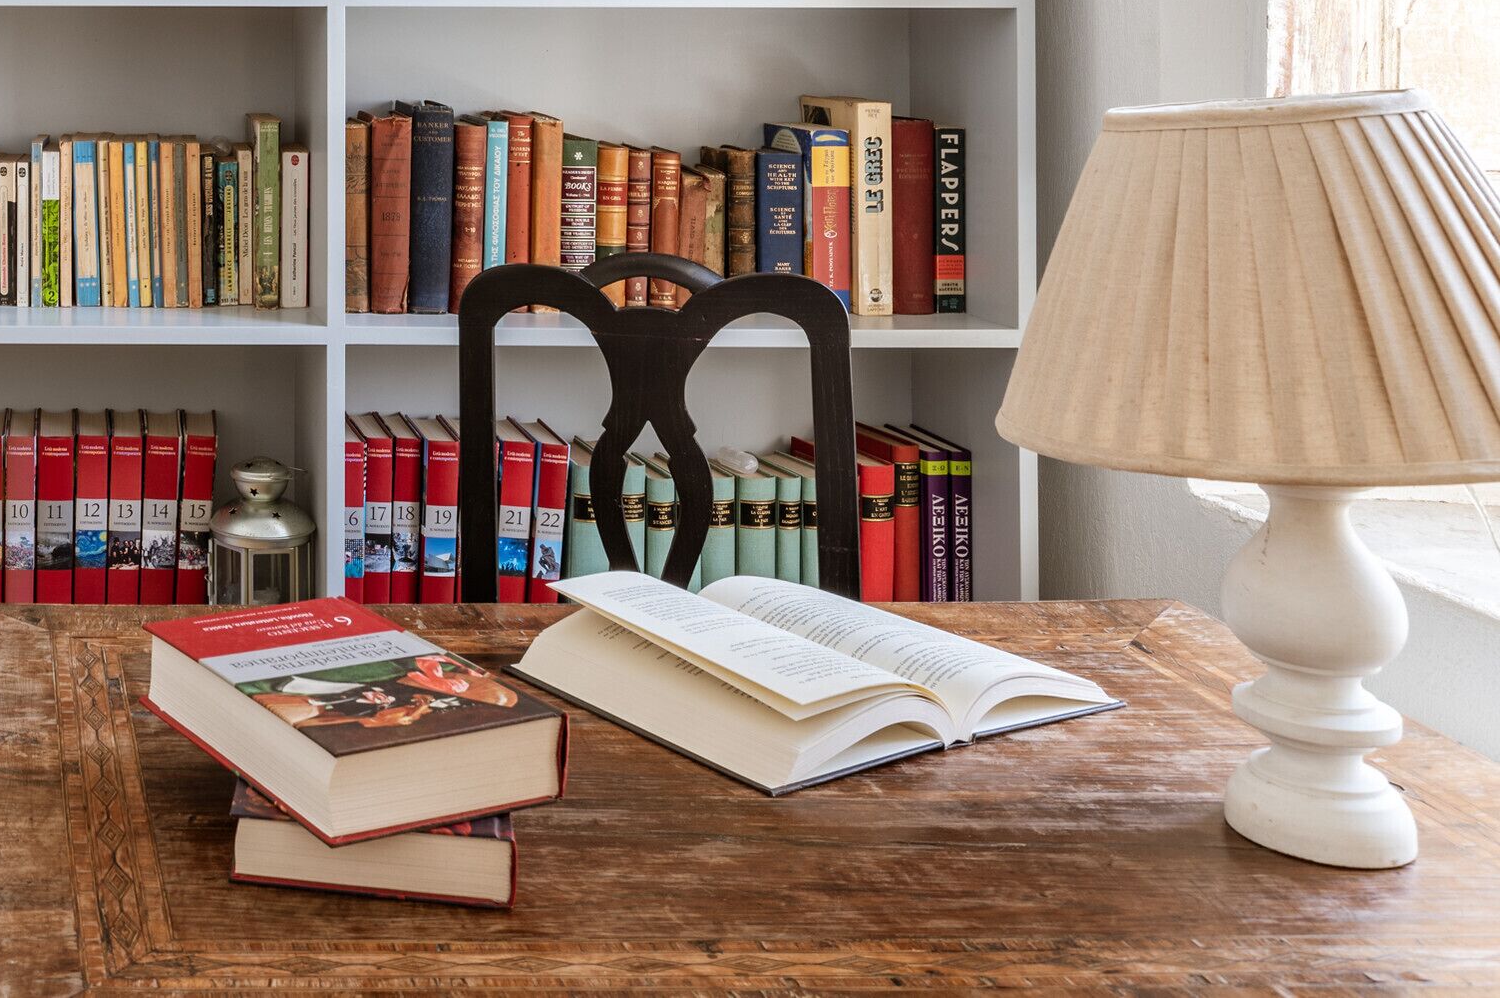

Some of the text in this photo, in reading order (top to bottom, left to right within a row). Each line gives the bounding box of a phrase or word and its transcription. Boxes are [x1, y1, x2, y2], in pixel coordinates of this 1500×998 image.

[416, 121, 450, 129] BANKER
[413, 135, 453, 143] CUSTOMER
[493, 145, 502, 176] ΔΙΚΑΙΟΥ
[864, 136, 884, 214] LE GREC
[492, 177, 501, 194] ΤΟΥ
[564, 181, 593, 192] BOOKS
[939, 133, 960, 251] FLAPPERS
[204, 203, 214, 216] SAS
[262, 215, 273, 233] REINES
[491, 194, 501, 246] ΦΙΛΟΣΟΦΙΑΣ
[241, 236, 249, 258] Michel
[262, 235, 273, 246] LES
[47, 290, 57, 303] 2
[11, 503, 29, 519] 10
[47, 504, 64, 519] 11
[84, 502, 100, 518] 12
[117, 503, 134, 519] 13
[152, 503, 169, 519] 14
[189, 503, 207, 519] 15
[369, 505, 388, 522] 17
[396, 505, 415, 521] 18
[434, 510, 452, 525] 19
[505, 510, 523, 526] 21
[540, 512, 561, 528] 22
[931, 493, 946, 558] ΛΕΞΙΚΟ
[954, 493, 969, 558] ΛΕΞΙΚΟ
[202, 611, 314, 633] Filosofia, Letteratura, Musica
[256, 618, 325, 633] L'età del Barocco
[333, 615, 352, 627] 6
[267, 623, 319, 638] SEICENTO
[231, 640, 393, 671] e contemporanea
[271, 645, 407, 672] L'età moderna
